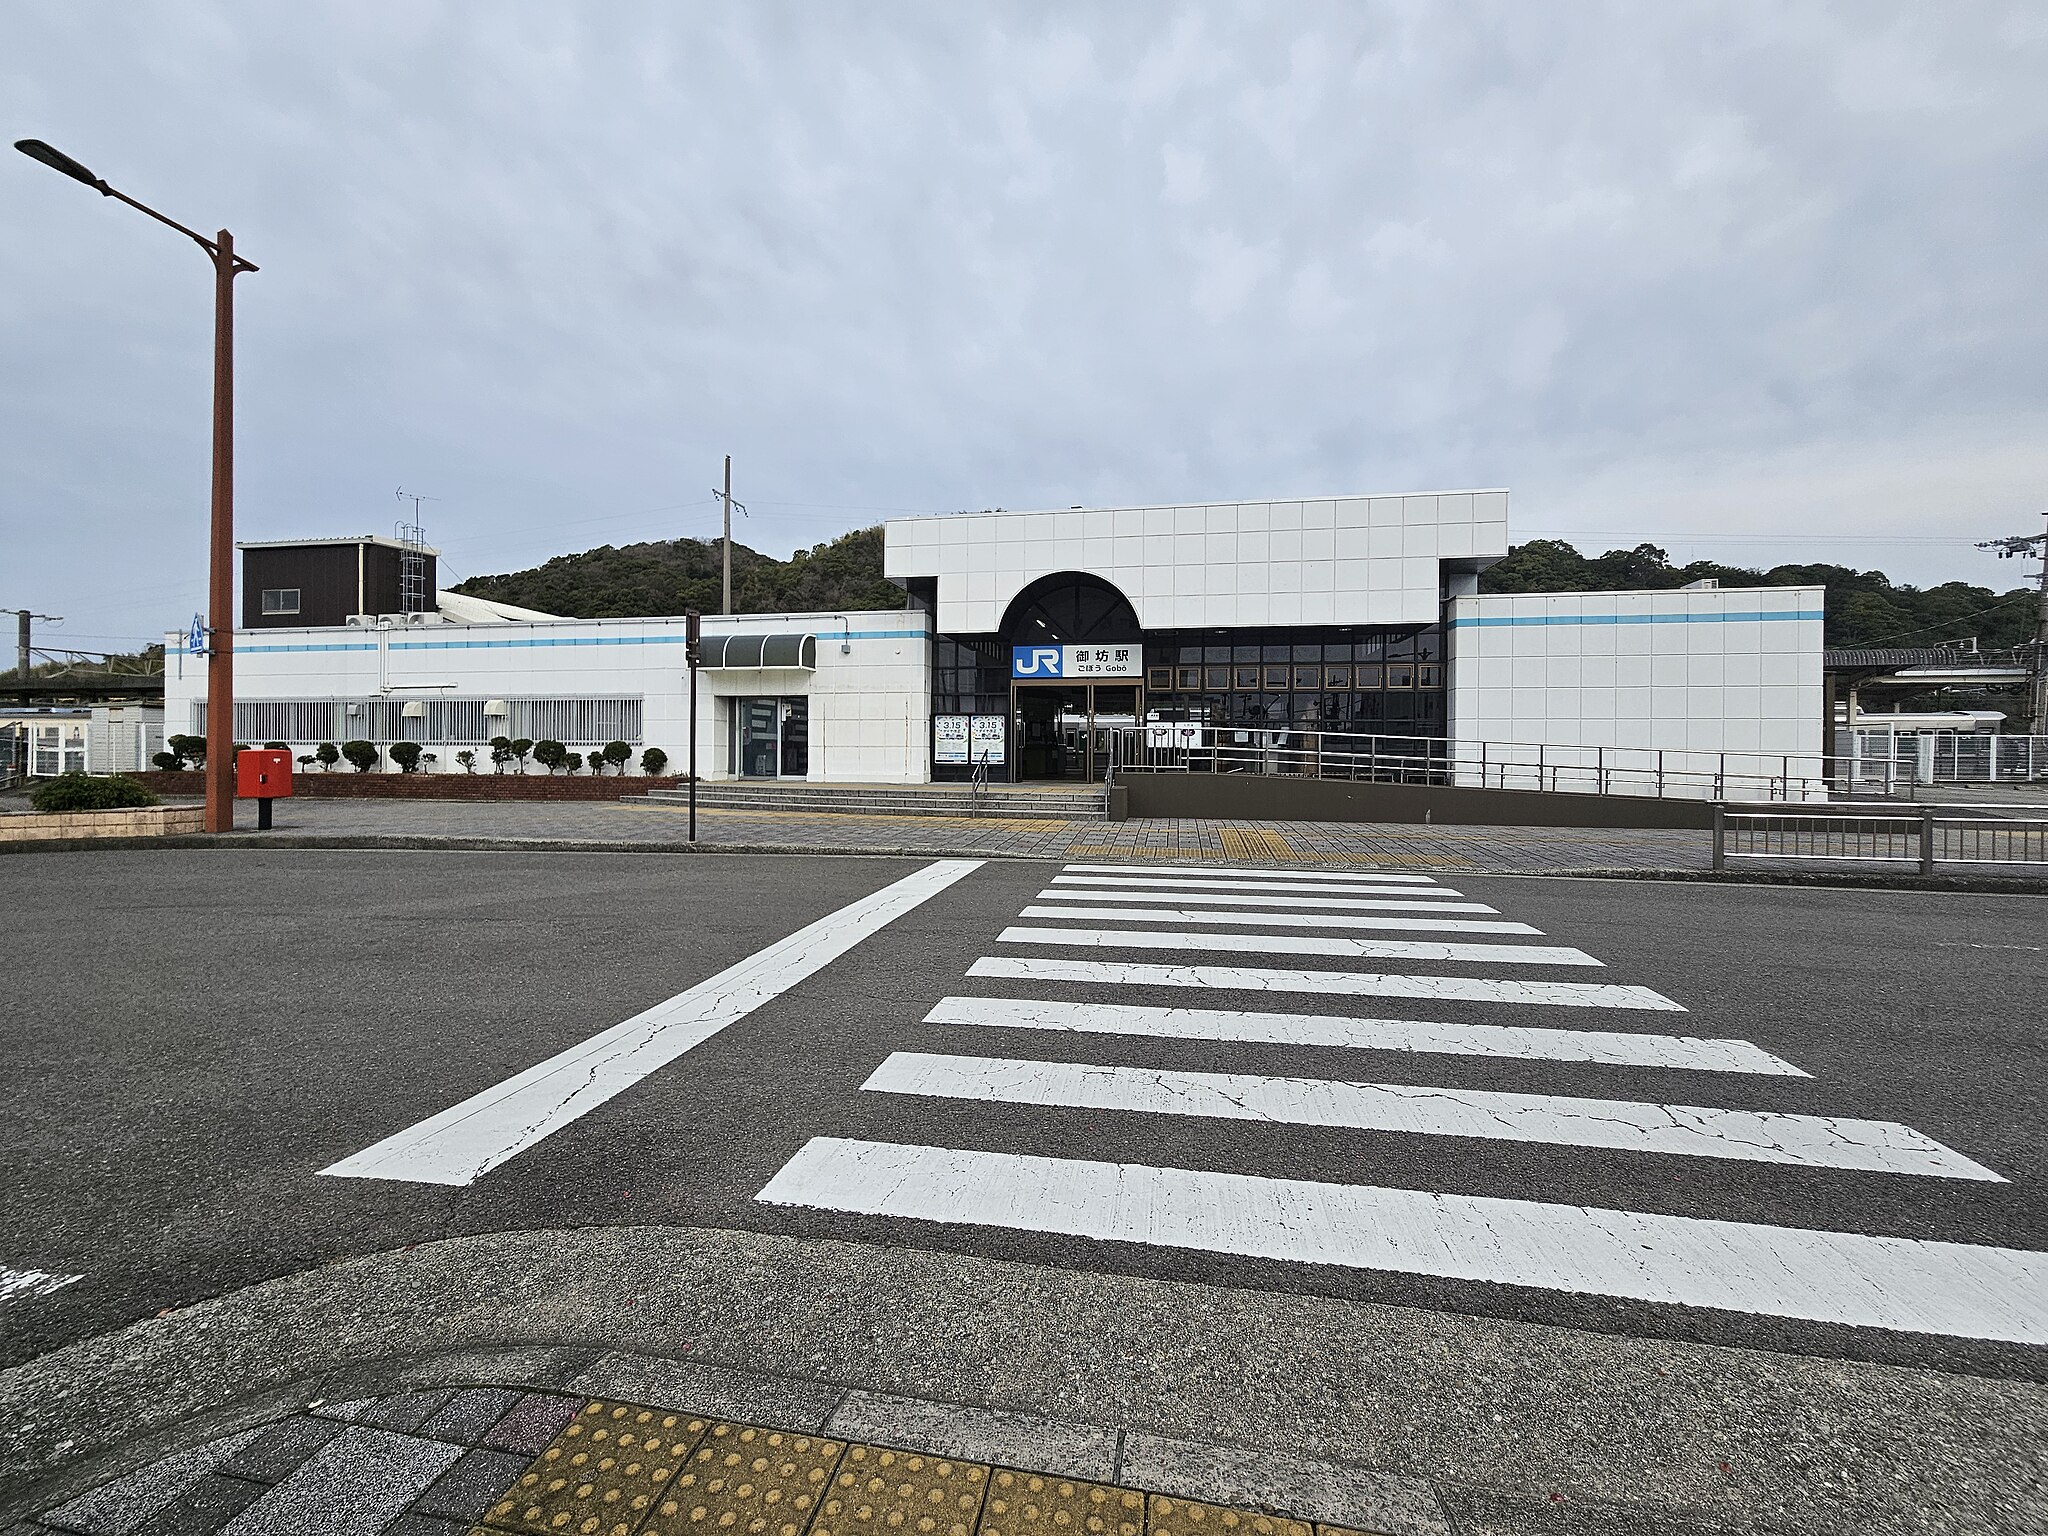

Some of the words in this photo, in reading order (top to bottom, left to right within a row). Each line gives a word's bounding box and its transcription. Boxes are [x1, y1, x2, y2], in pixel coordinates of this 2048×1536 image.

[1075, 649, 1129, 662] 御坊駅
[1016, 649, 1060, 674] JR
[1078, 664, 1102, 672] ごぼう
[943, 721, 961, 729] 3.15
[979, 721, 997, 729] 3.15
